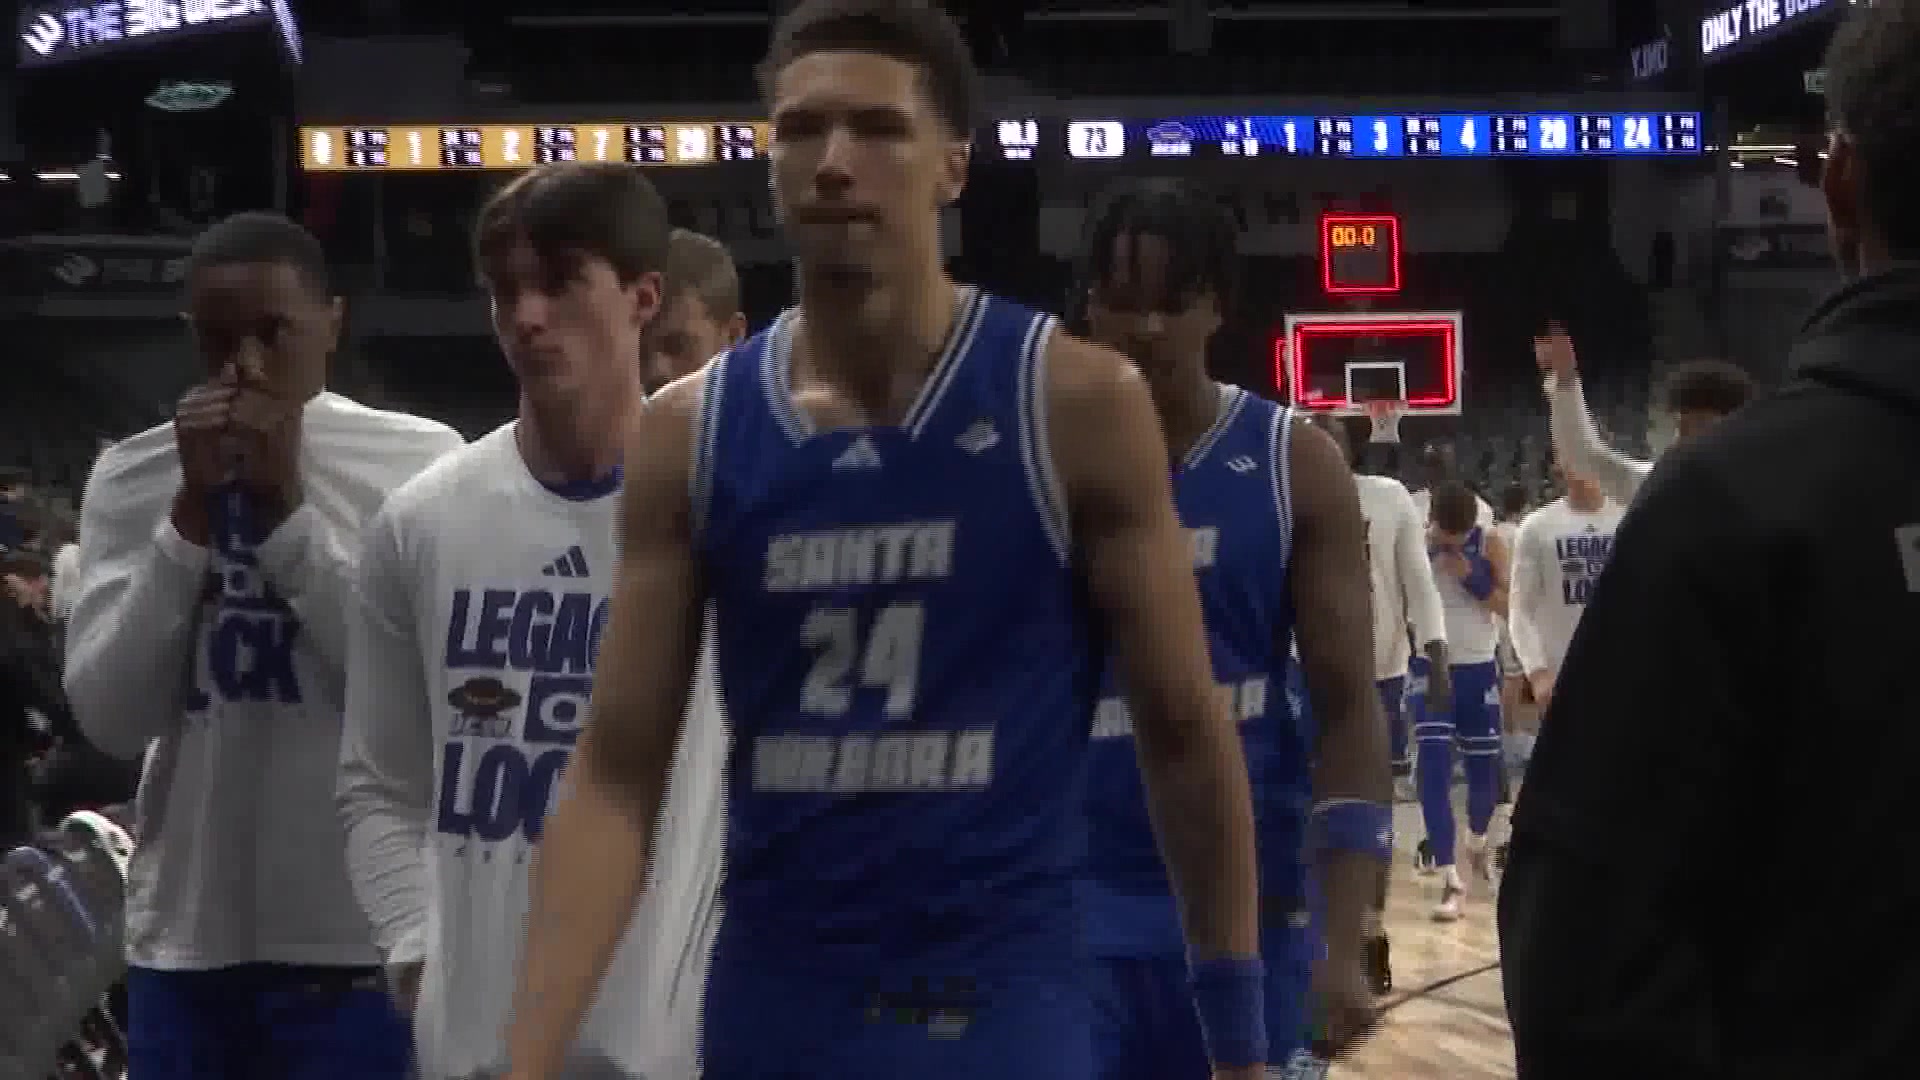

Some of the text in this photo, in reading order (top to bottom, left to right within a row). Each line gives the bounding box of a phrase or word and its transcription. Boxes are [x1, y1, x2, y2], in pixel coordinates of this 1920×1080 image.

[64, 2, 123, 48] THE
[1702, 8, 1743, 54] ONLY
[1745, 0, 1783, 34] THE
[406, 131, 421, 164] 1
[502, 129, 520, 162] 2
[592, 128, 608, 160] 7
[1083, 126, 1107, 153] 73
[1283, 121, 1296, 153] 1
[1373, 120, 1388, 152] 3
[1459, 119, 1476, 149] 4
[1624, 116, 1651, 148] 24
[762, 521, 955, 591] SANTA
[800, 602, 923, 720] 24
